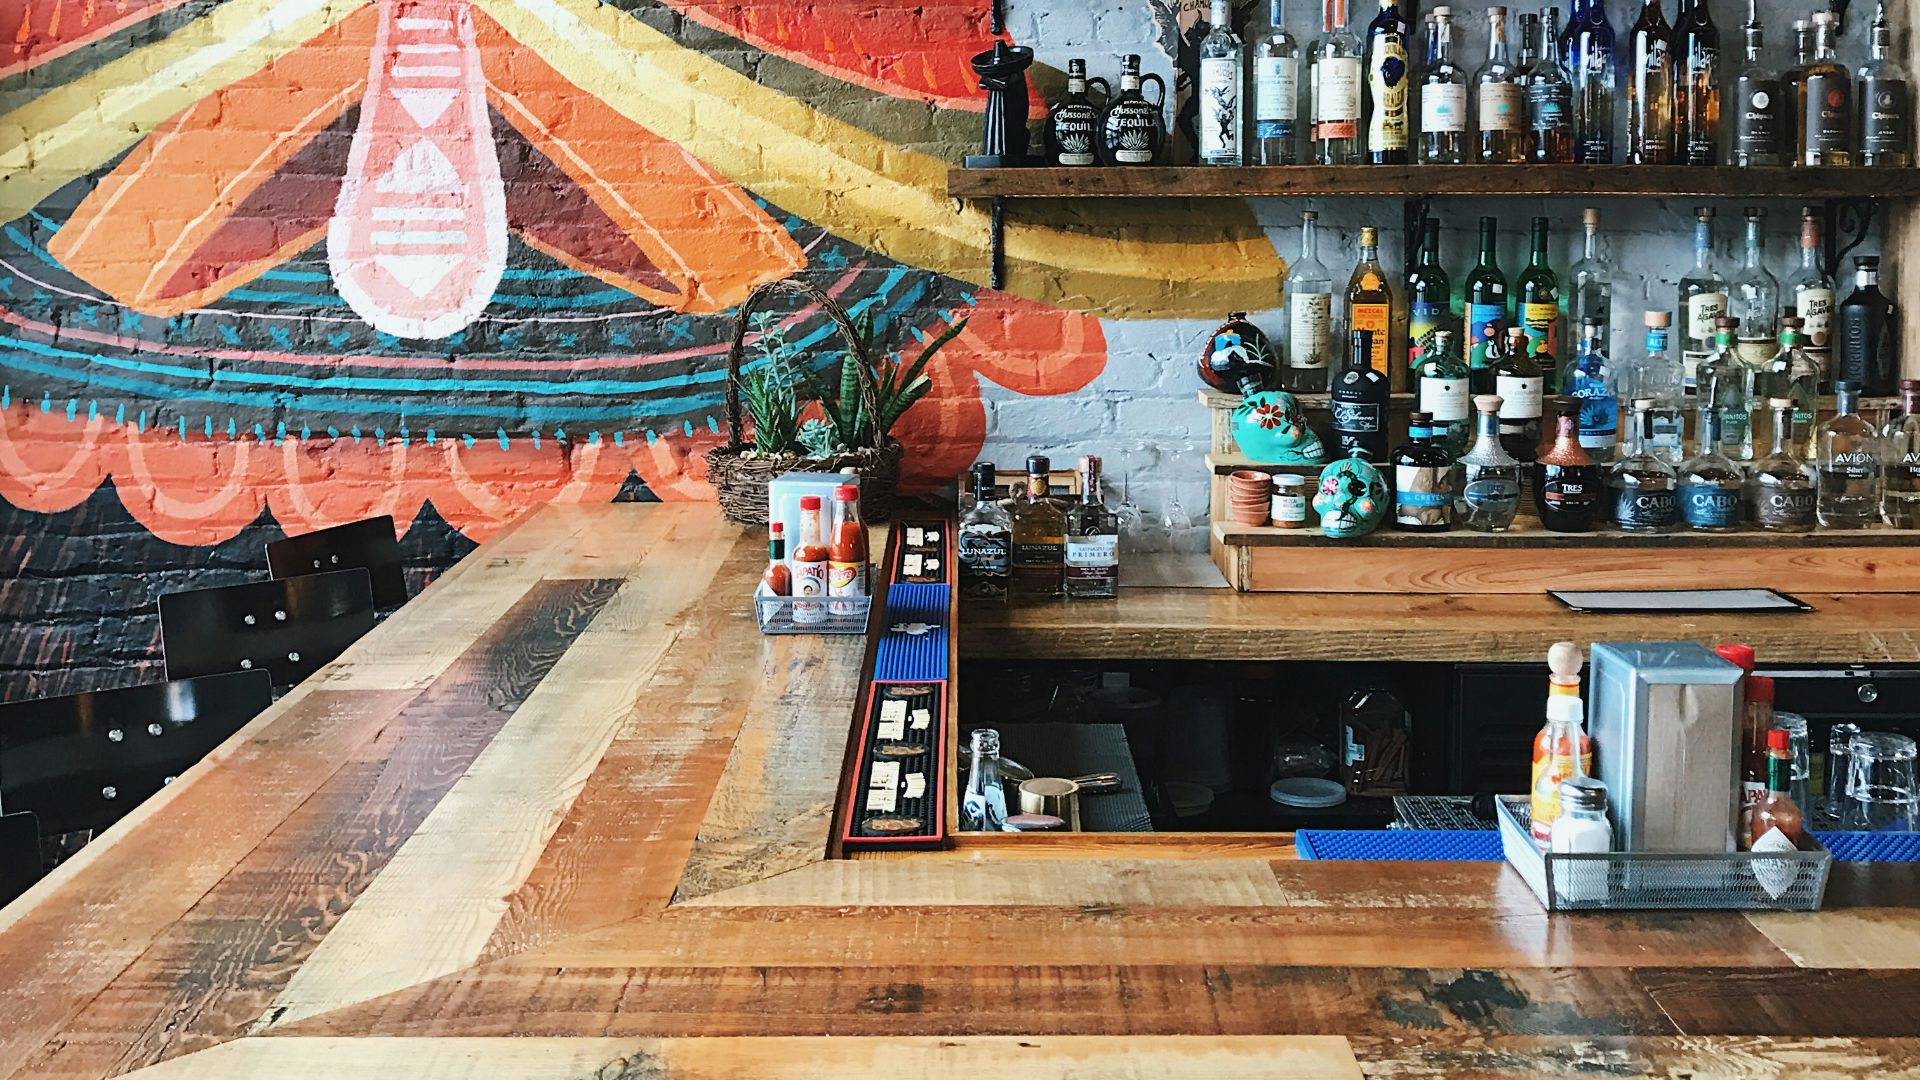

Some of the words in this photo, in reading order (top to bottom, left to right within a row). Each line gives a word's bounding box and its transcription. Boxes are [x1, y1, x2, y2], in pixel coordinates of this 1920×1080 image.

[1700, 304, 1719, 313] TRES
[1810, 300, 1828, 311] TRES
[1412, 307, 1440, 316] VID
[1562, 483, 1583, 493] TRES
[1636, 496, 1676, 509] CABO
[1692, 494, 1738, 507] CABO
[1769, 495, 1813, 507] CABO
[962, 547, 1007, 555] LUNAZUL
